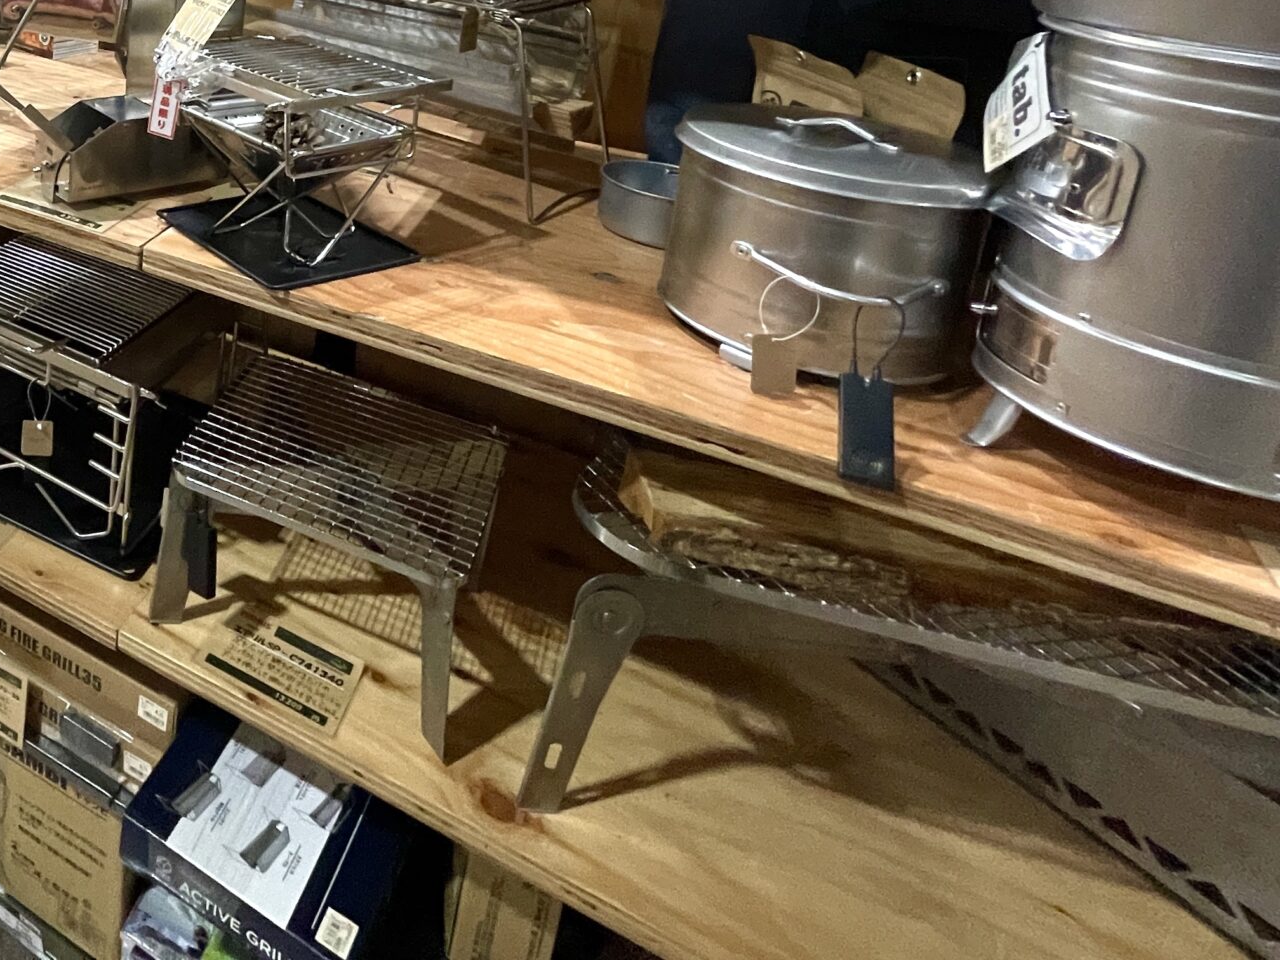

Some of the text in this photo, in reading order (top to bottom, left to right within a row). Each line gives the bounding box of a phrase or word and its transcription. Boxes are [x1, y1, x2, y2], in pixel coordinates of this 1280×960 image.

[1011, 63, 1034, 138] tab.
[9, 623, 41, 657] FIRE
[41, 645, 103, 693] GRILL35
[178, 882, 242, 935] ACTIVE
[246, 930, 291, 960] GRIL
